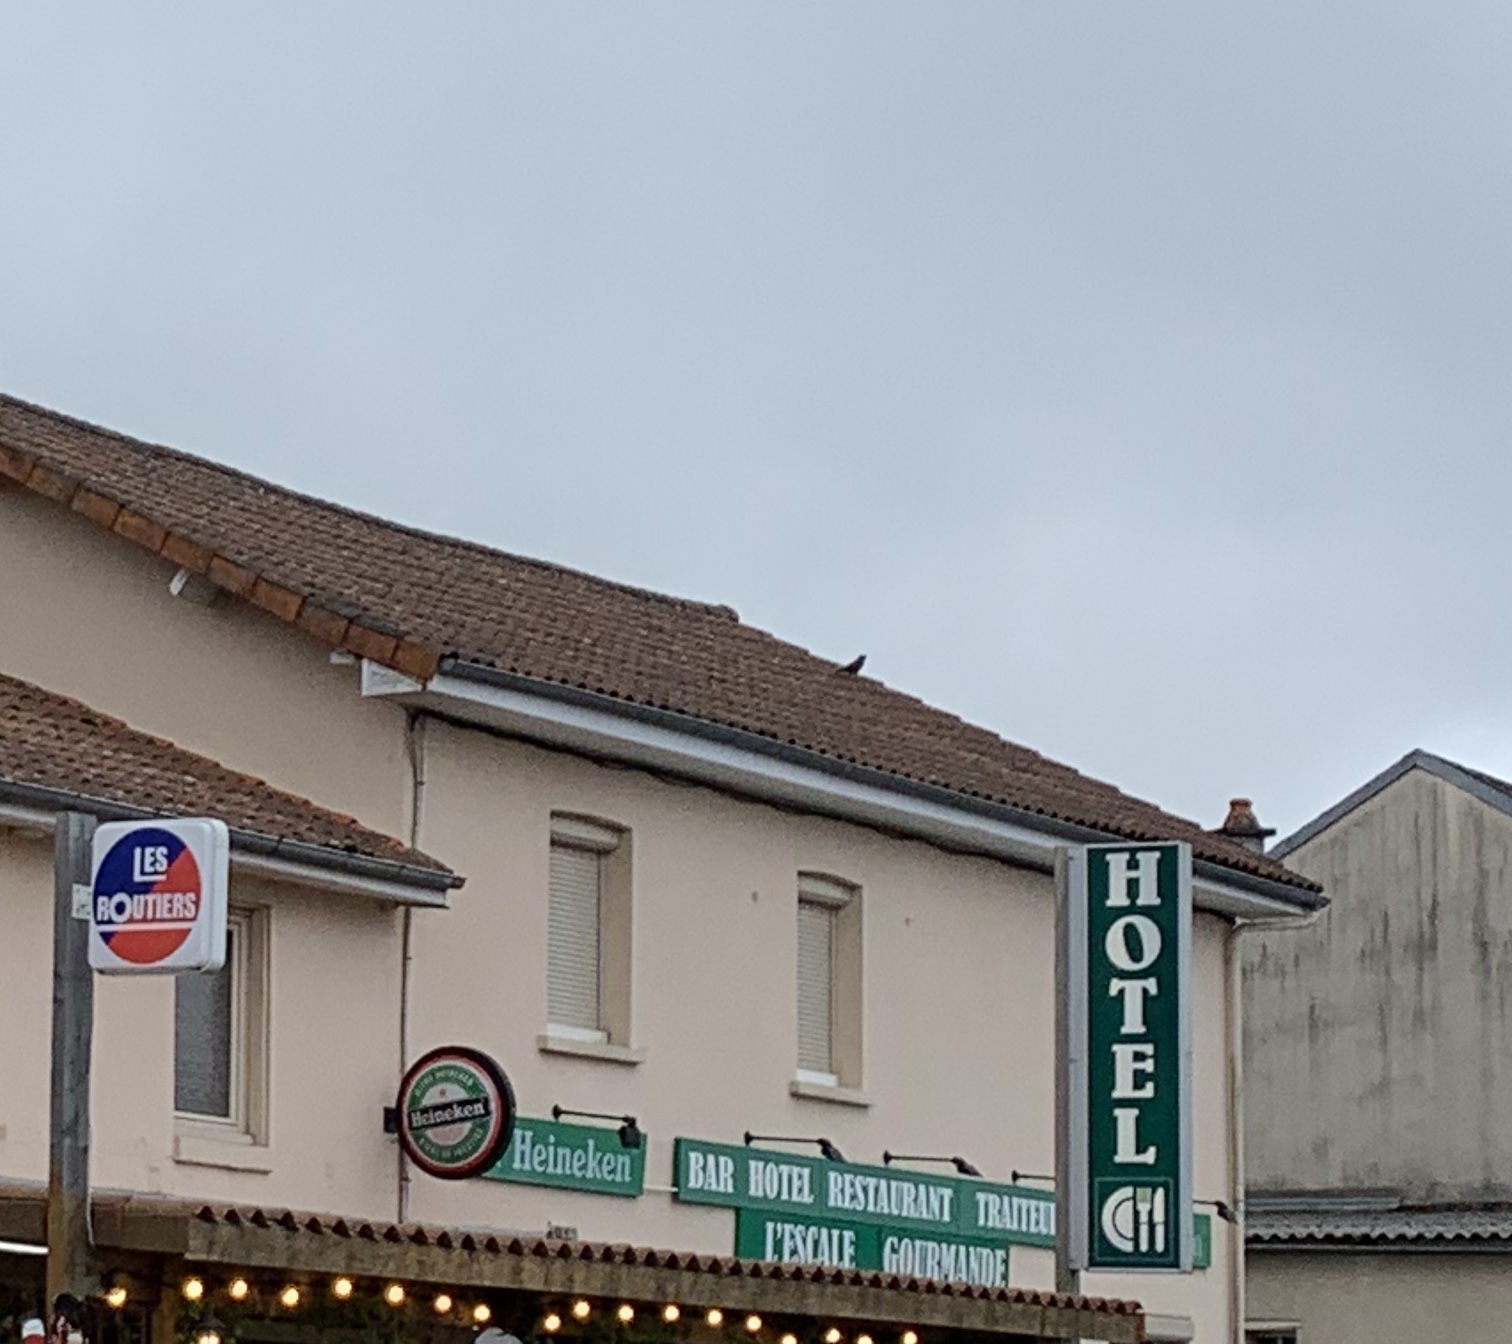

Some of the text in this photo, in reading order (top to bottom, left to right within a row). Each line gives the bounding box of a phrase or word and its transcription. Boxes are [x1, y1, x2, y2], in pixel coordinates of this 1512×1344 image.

[133, 846, 168, 882] LES
[97, 892, 196, 923] ROUTIERS
[1104, 850, 1163, 1166] HOTEL
[410, 1100, 486, 1128] Heineken
[512, 1127, 632, 1183] Heineken
[688, 1151, 735, 1194] BAR
[748, 1159, 815, 1204] HOTEL
[827, 1170, 954, 1223] RESTAURANT
[764, 1220, 1007, 1279] L'ESCALE GOURMANDE
